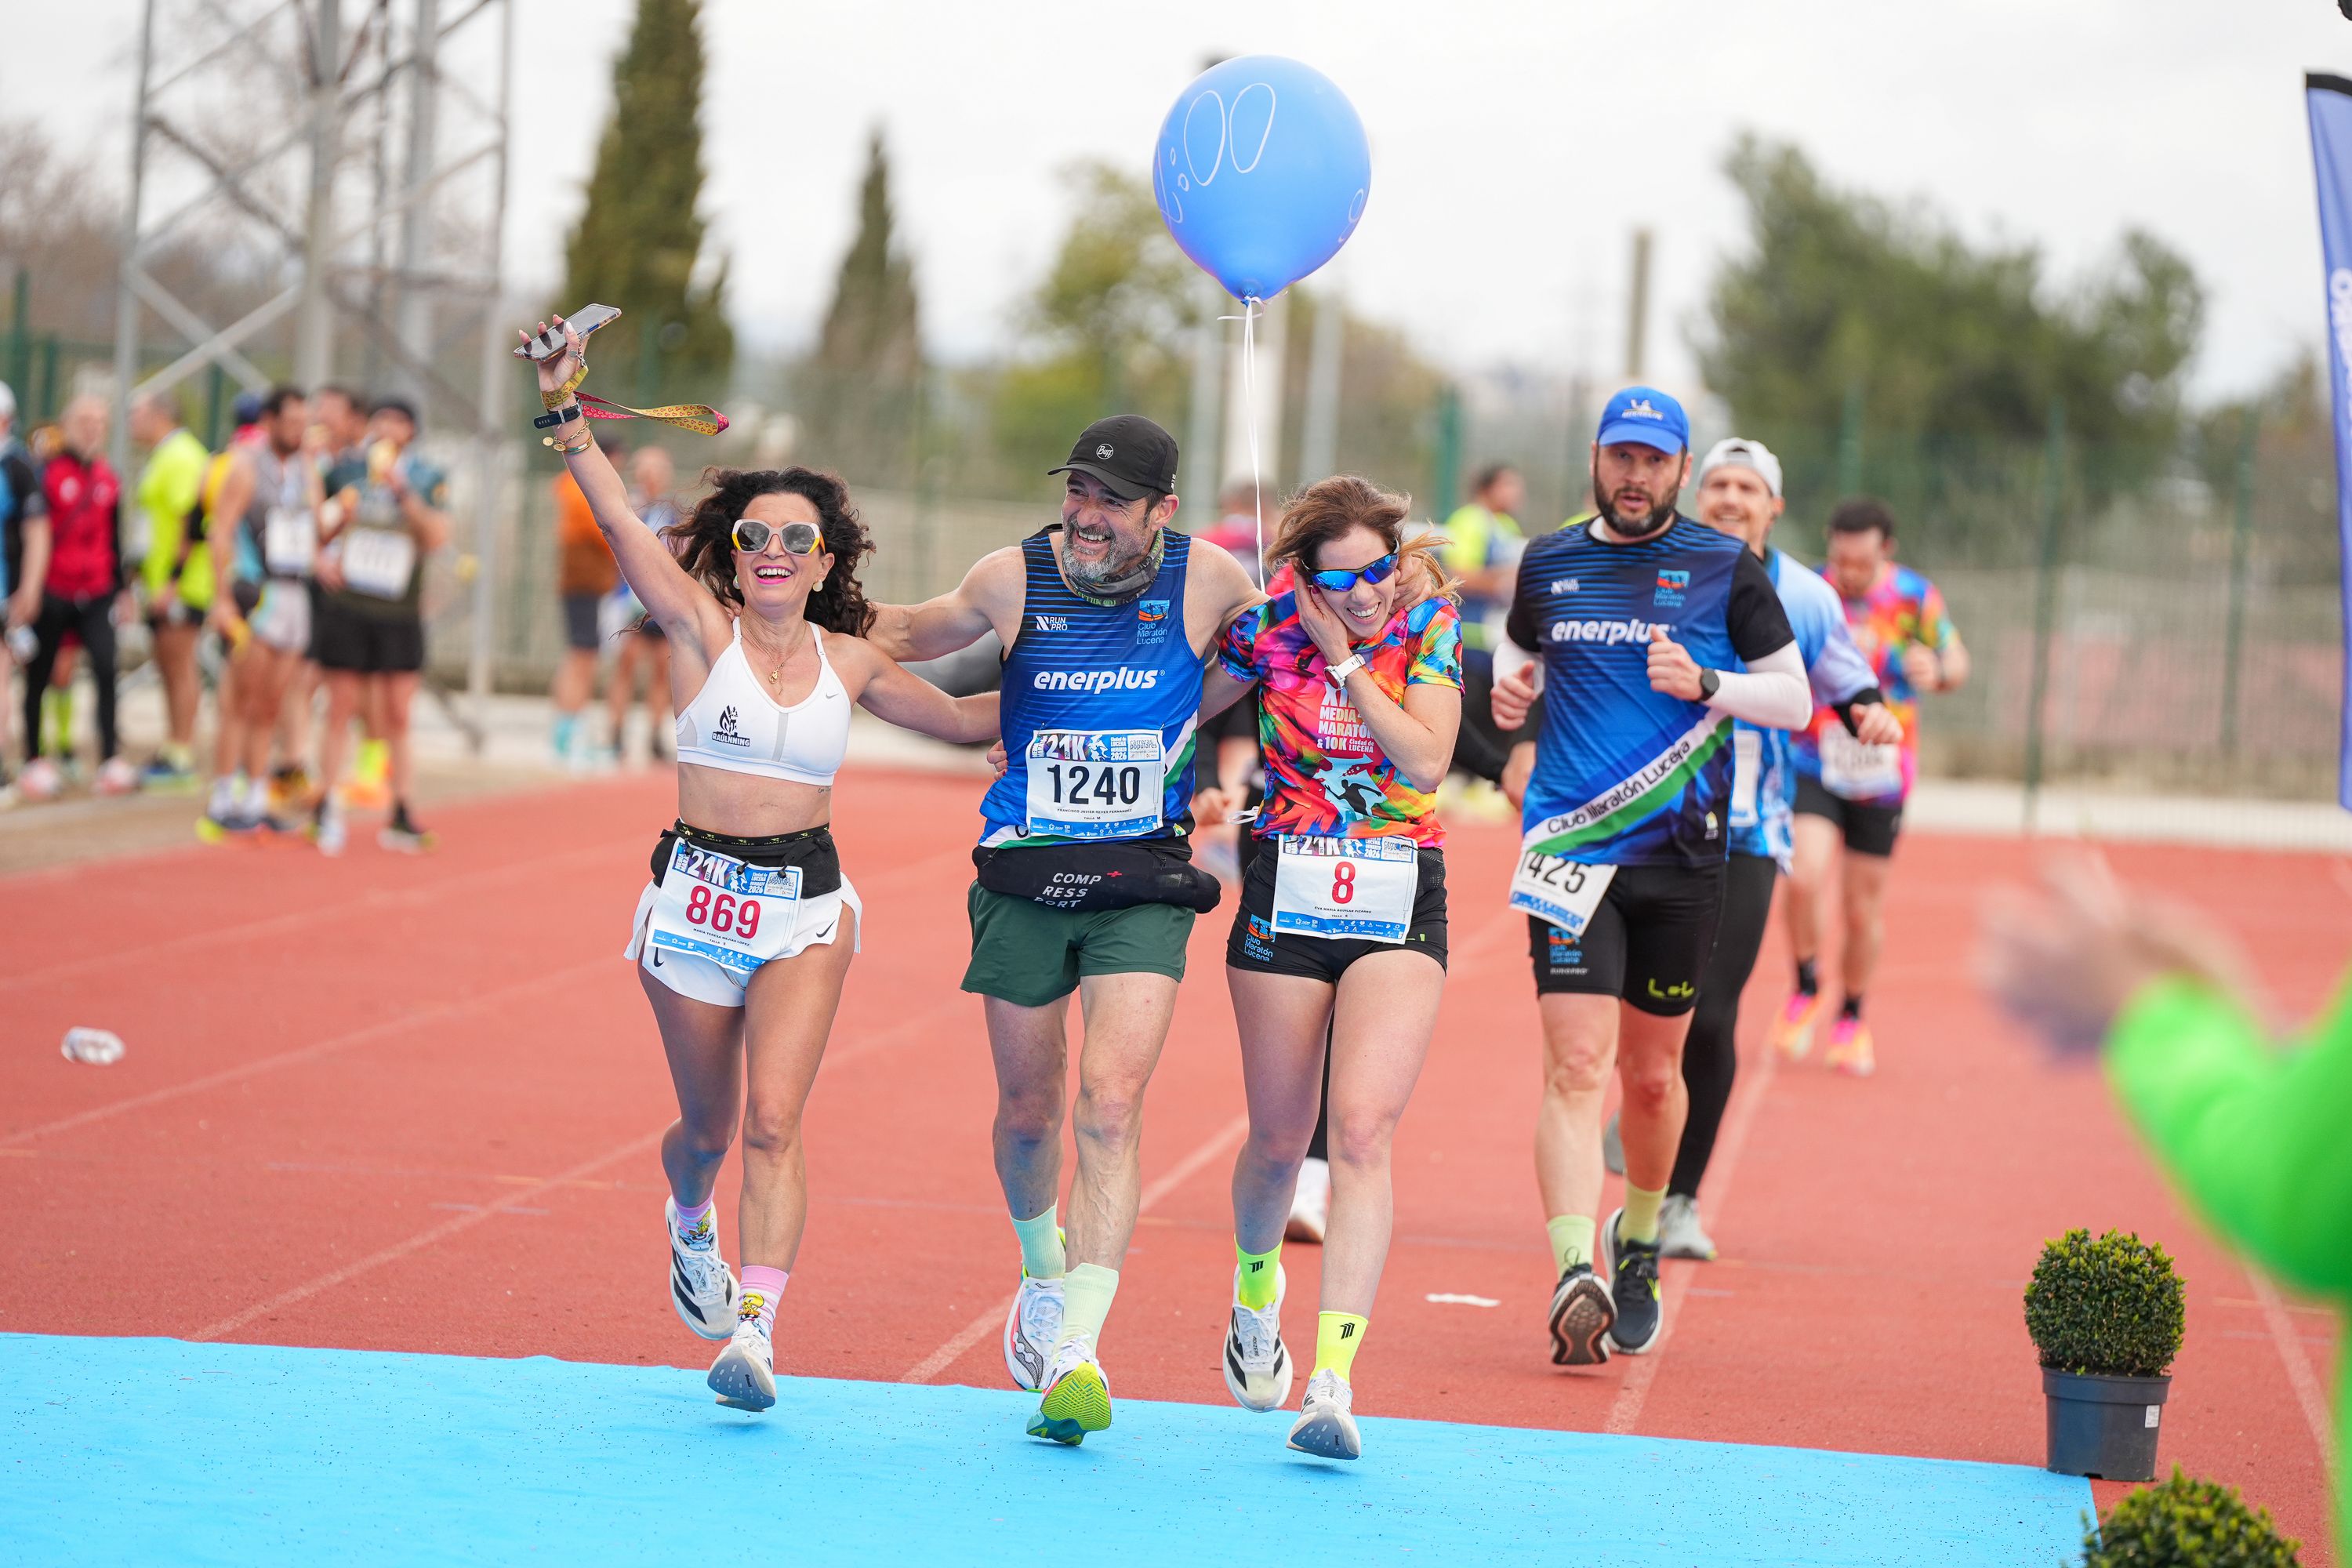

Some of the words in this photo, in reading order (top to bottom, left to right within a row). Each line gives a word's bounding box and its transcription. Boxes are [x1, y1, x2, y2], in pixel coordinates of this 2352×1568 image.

[1137, 627, 1167, 637] Maratón
[1137, 637, 1165, 645] Lucena
[1034, 666, 1159, 695] enerplus
[1319, 706, 1356, 723] MEDIA
[712, 732, 750, 746] RAULNNING
[1317, 739, 1323, 749] &
[1324, 736, 1348, 751] 10K
[1348, 738, 1367, 746] Ciudad
[1046, 735, 1087, 760] 21K
[1110, 752, 1127, 760] 2026
[1047, 764, 1140, 805] 1240
[1548, 811, 1587, 834] Club
[1299, 835, 1341, 856] 21K
[1365, 848, 1381, 858] 2026
[686, 850, 731, 887] 21K
[1052, 873, 1102, 885] COMP
[1331, 861, 1356, 904] 8
[748, 885, 764, 894] 2026
[1042, 885, 1088, 898] RESS
[1033, 896, 1084, 908] PORT
[685, 885, 761, 939] 869
[1246, 934, 1261, 945] Club
[1244, 941, 1273, 957] Maratón
[1244, 948, 1270, 962] Lucena
